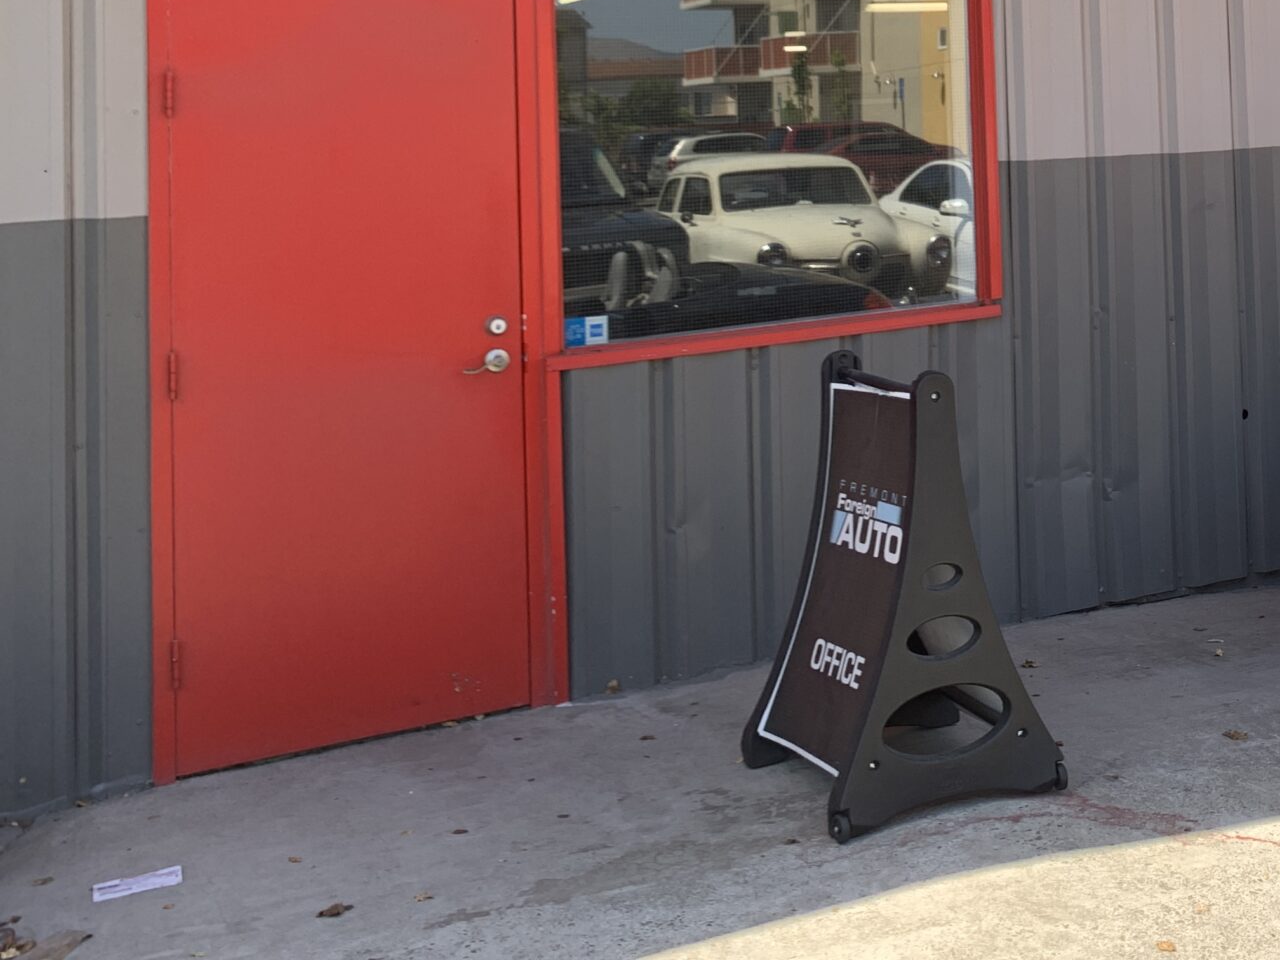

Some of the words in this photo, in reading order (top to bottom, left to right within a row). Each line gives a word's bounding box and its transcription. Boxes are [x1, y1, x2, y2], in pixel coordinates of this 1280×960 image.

[836, 492, 877, 520] Foreign
[839, 478, 908, 507] FREMONT
[835, 512, 903, 565] AUTO
[810, 638, 866, 690] OFFICE
